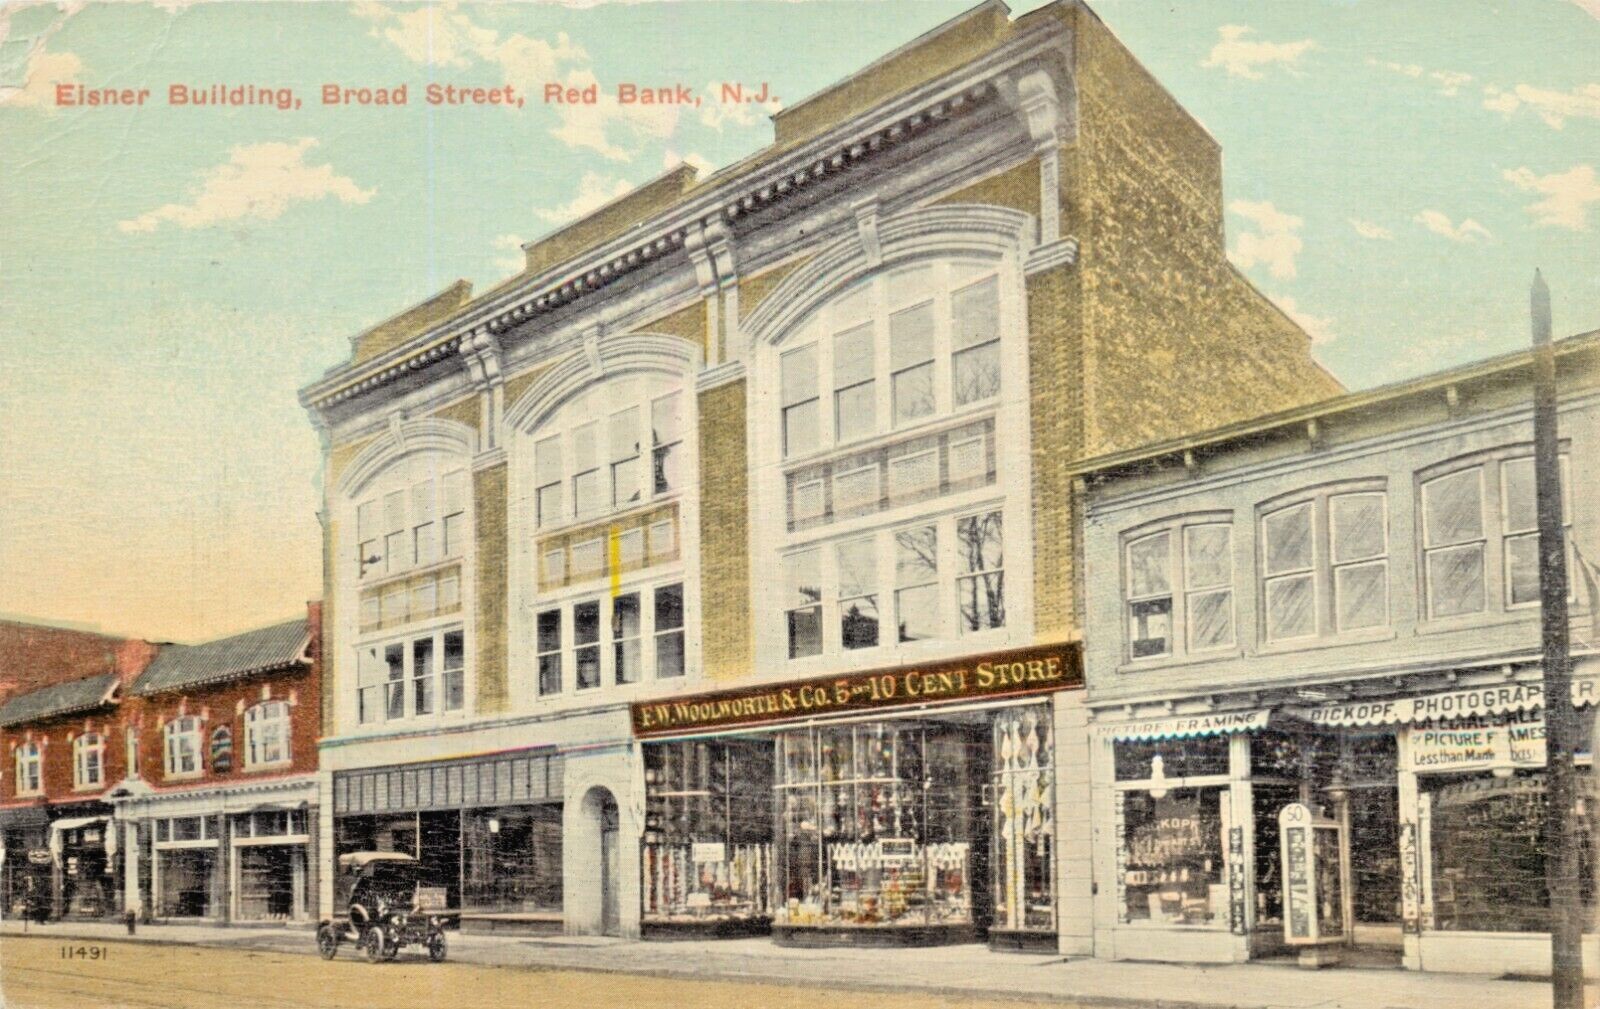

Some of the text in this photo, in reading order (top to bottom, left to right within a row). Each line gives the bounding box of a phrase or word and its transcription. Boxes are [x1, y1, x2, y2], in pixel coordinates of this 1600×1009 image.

[779, 688, 797, 711] &
[834, 679, 850, 704] 5
[869, 674, 897, 700] 10
[904, 669, 969, 697] CENT
[975, 657, 1063, 688] STORE
[1413, 680, 1594, 715] PHOTOGRAPR
[1175, 711, 1256, 731] FRAMING
[1424, 732, 1483, 746] PICTURE
[1486, 726, 1549, 745] FAMES
[1414, 750, 1439, 766] Less
[1440, 748, 1463, 763] than
